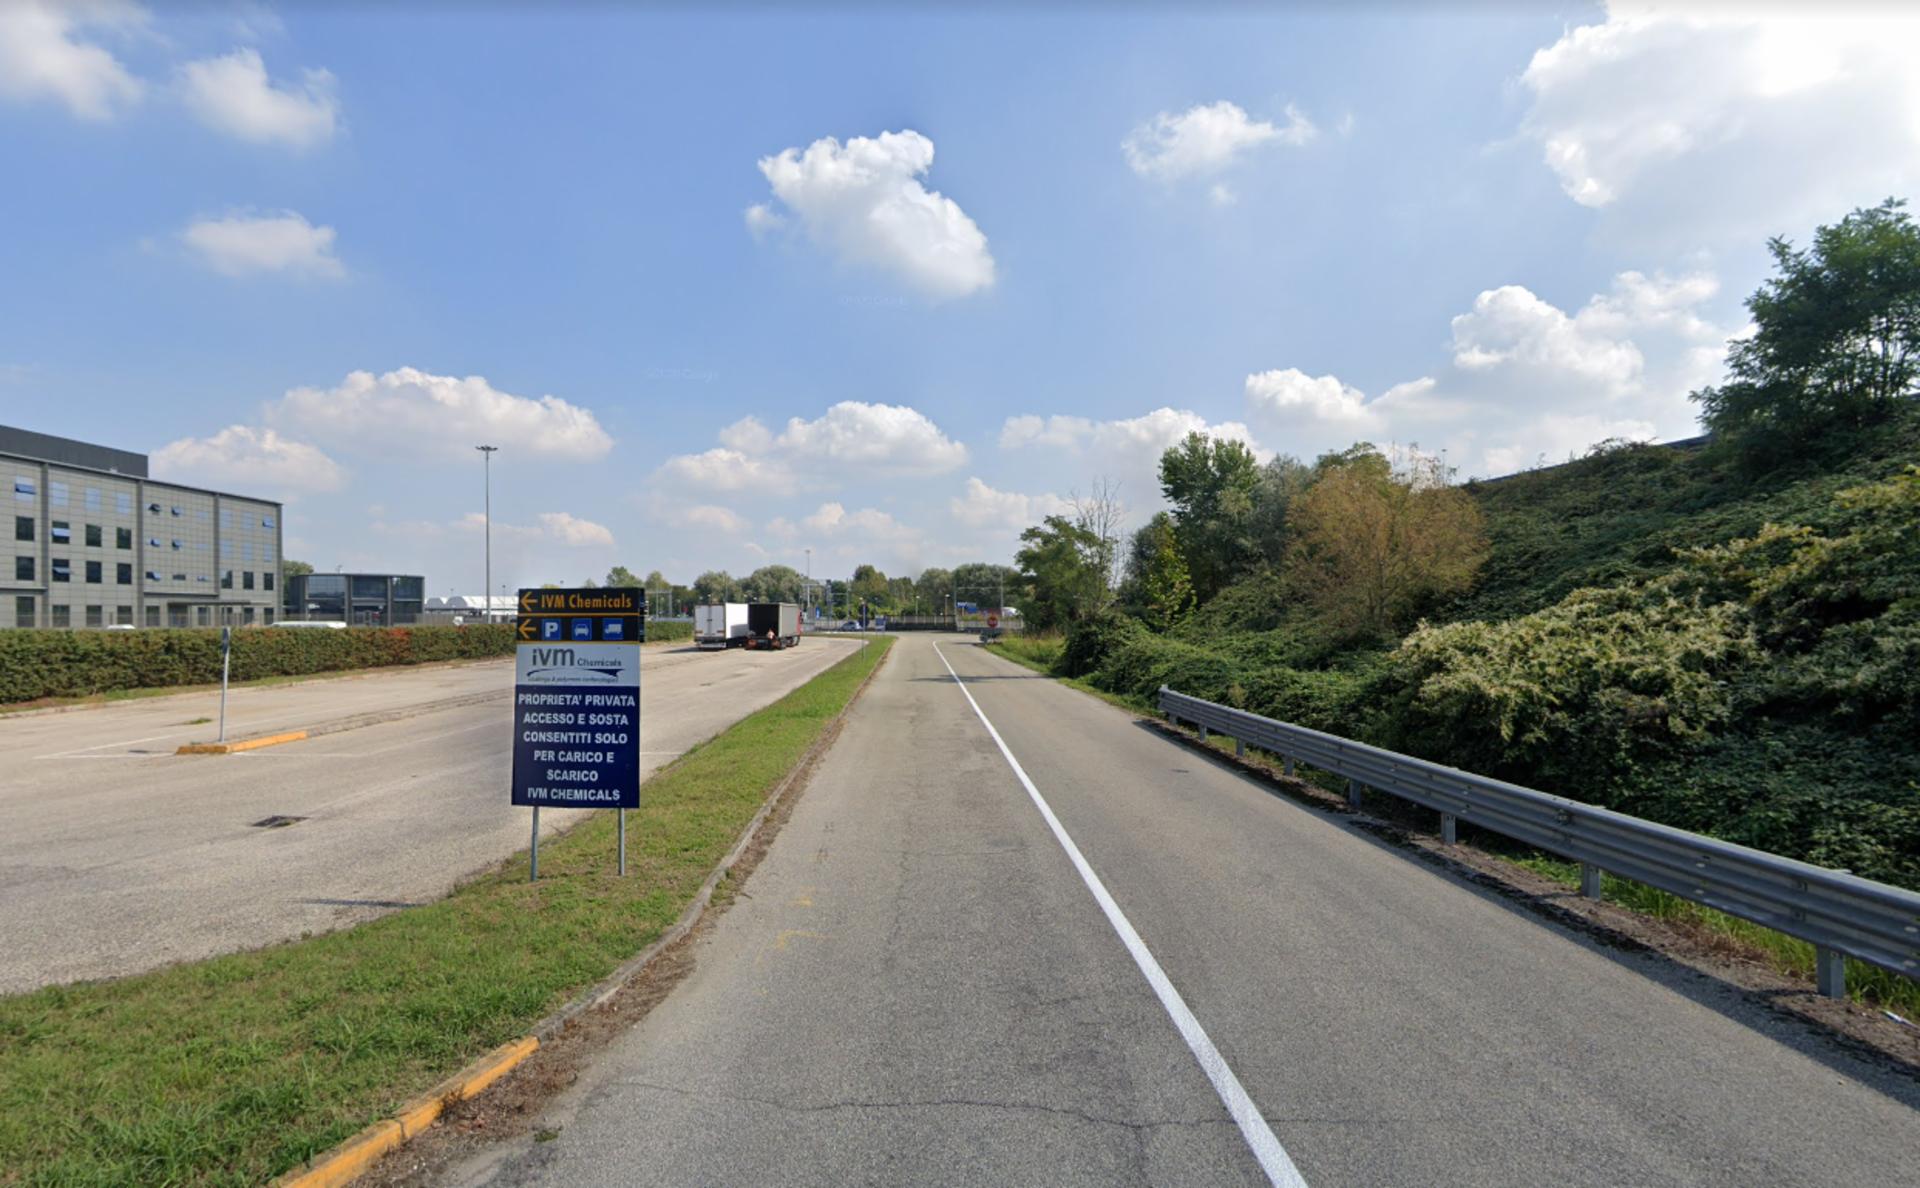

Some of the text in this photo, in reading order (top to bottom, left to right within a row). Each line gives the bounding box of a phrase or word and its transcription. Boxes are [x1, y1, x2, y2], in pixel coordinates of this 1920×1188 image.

[541, 593, 632, 609] IVM Chemicals
[544, 622, 559, 638] P
[577, 657, 622, 667] Chemicals
[518, 693, 636, 707] PROPRIETA' PRIVATA
[523, 712, 629, 726] ACCESSO E SOSTA
[523, 731, 628, 745] CONSENTITI SOLO
[533, 750, 615, 763] PER CARICO E
[546, 769, 599, 782] SCARICO
[527, 787, 620, 801] IVM CHEMICALS
